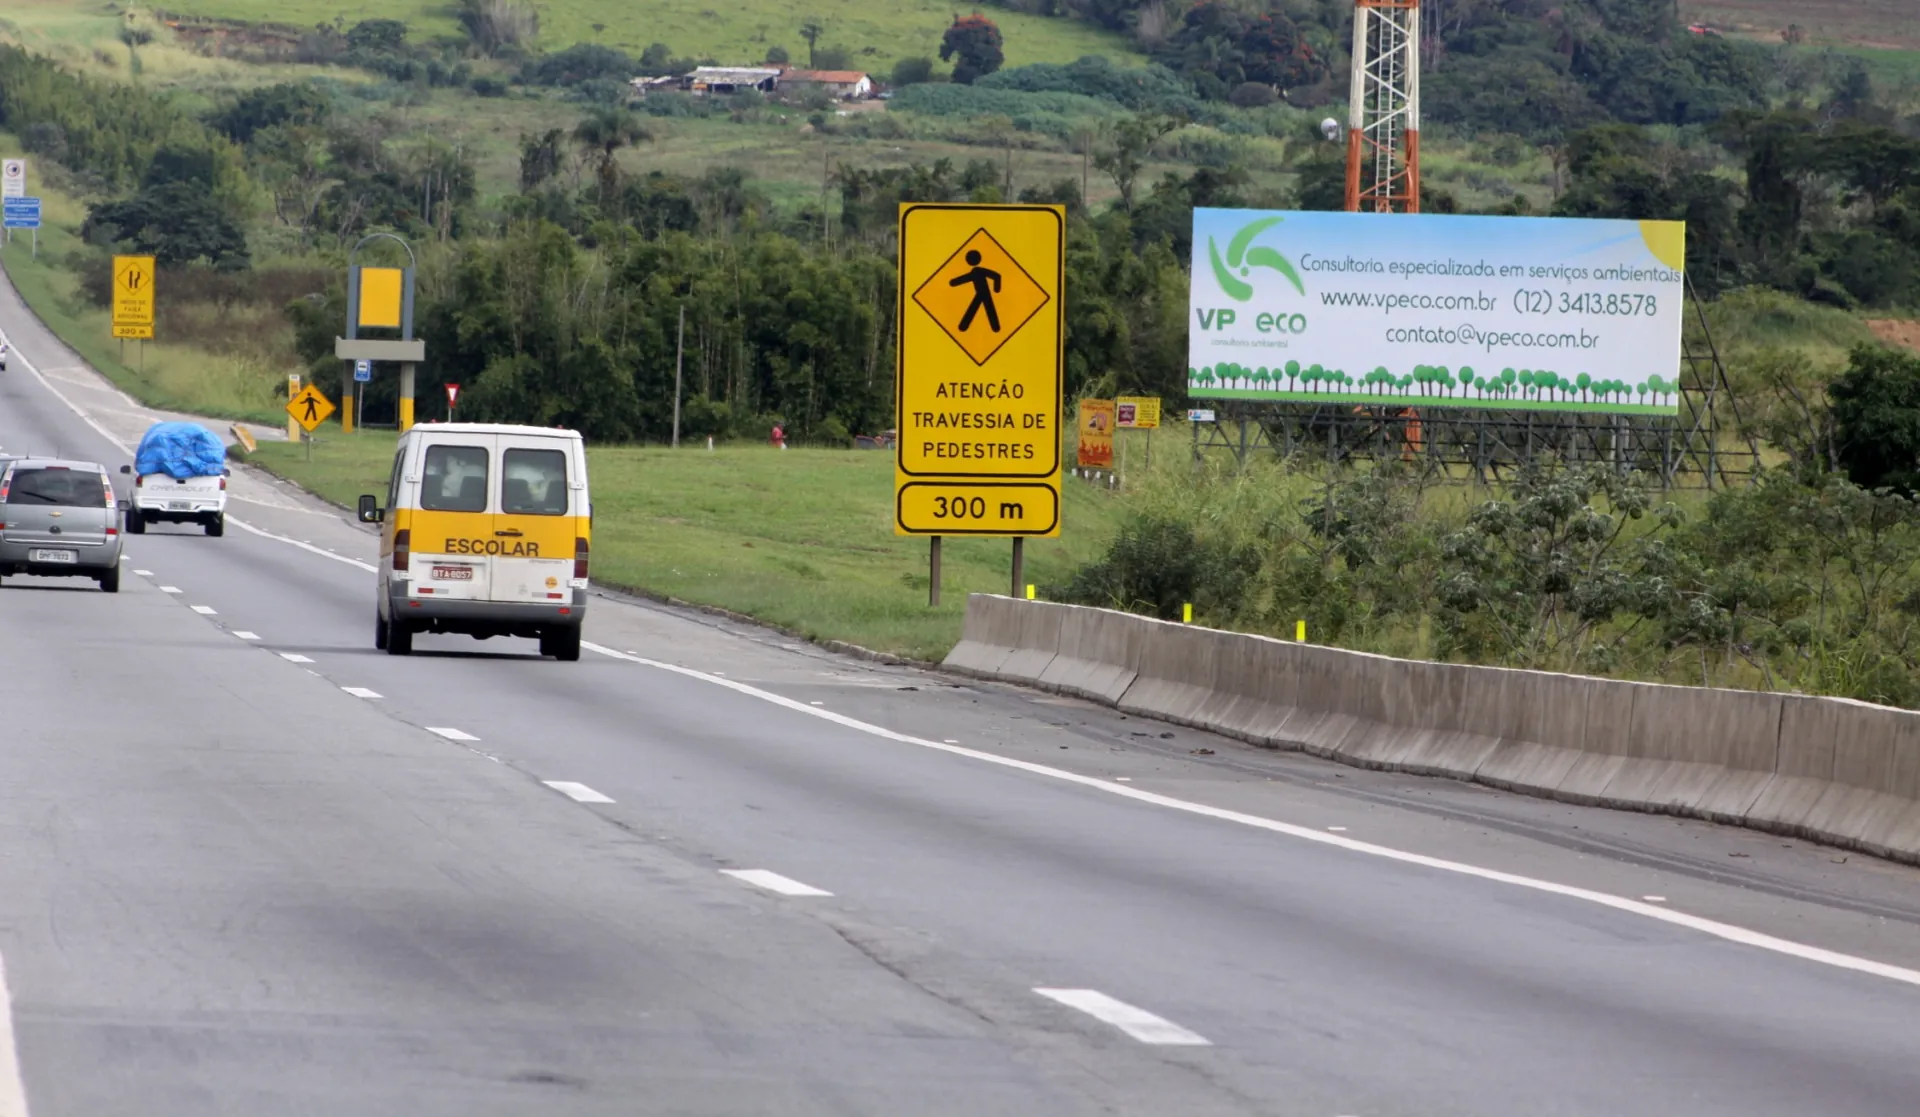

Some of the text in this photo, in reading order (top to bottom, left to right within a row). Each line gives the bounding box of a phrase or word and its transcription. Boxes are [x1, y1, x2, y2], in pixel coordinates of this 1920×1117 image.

[1300, 253, 1681, 284] Consultoria especializada em serviços ambientais
[1320, 288, 1657, 316] www.vpeco.com.br (12) 3413.8578
[1196, 307, 1307, 334] VP eco
[1386, 324, 1600, 353] contato@vpeco.com.br
[936, 379, 1024, 400] ATENÇÃO
[912, 412, 1046, 429] TRAVESSIA DE
[923, 442, 1034, 459] PEDESTRES
[933, 496, 1023, 519] 300 m
[445, 538, 539, 557] ESCOLAR
